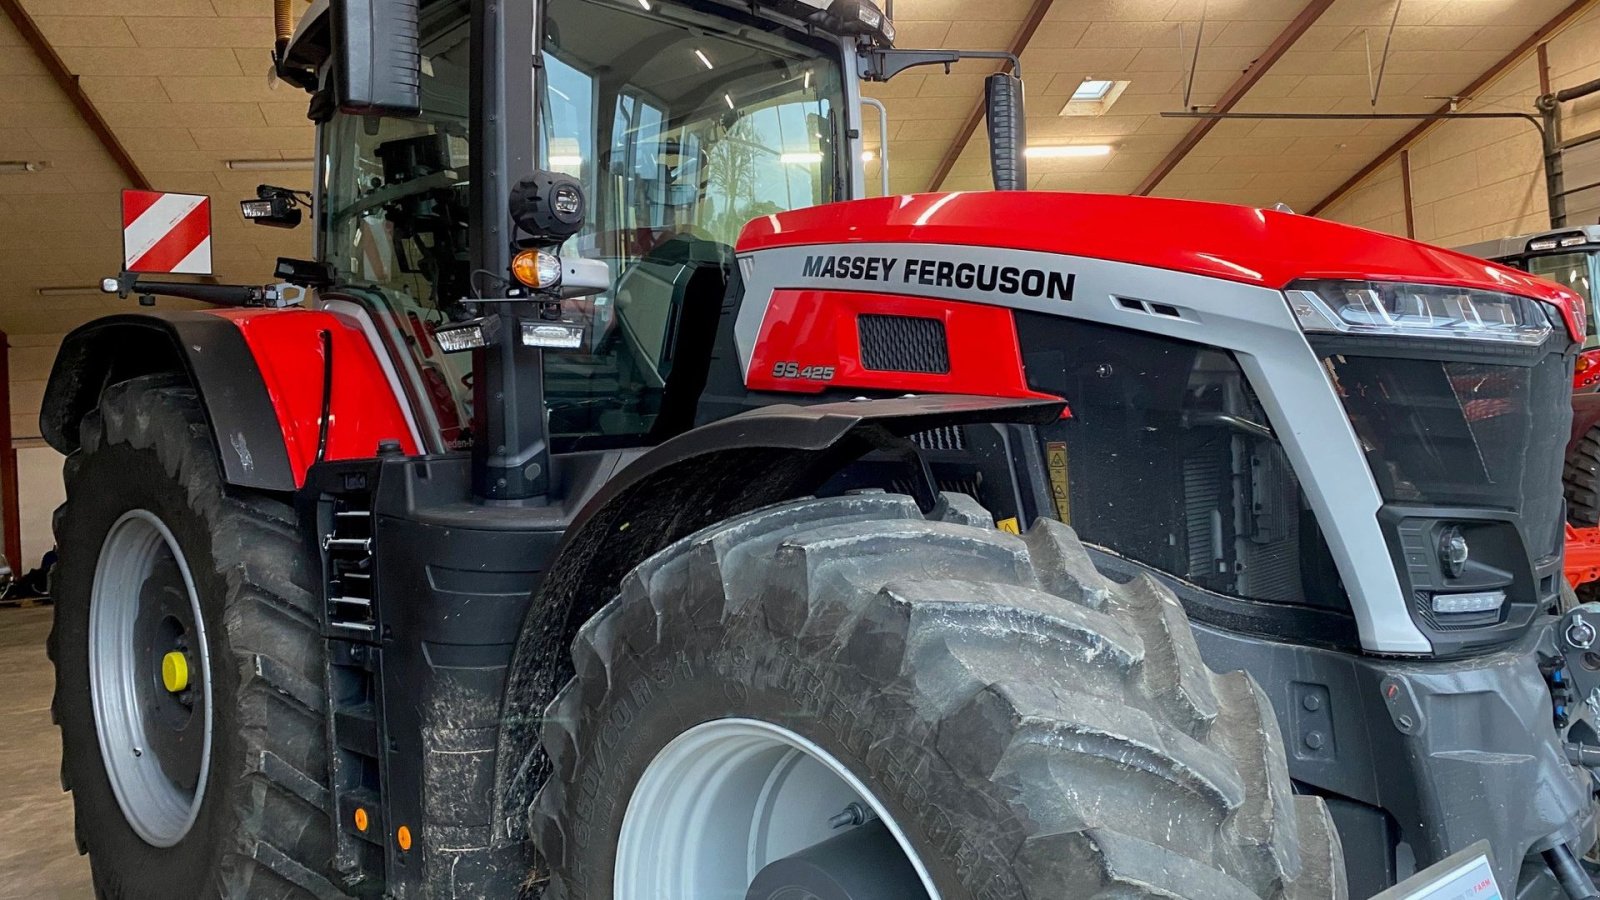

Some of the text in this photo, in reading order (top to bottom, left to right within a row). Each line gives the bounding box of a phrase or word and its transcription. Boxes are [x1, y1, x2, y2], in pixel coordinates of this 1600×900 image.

[802, 255, 1076, 302] MASSEY FERGUSON
[772, 361, 835, 380] 9S.425
